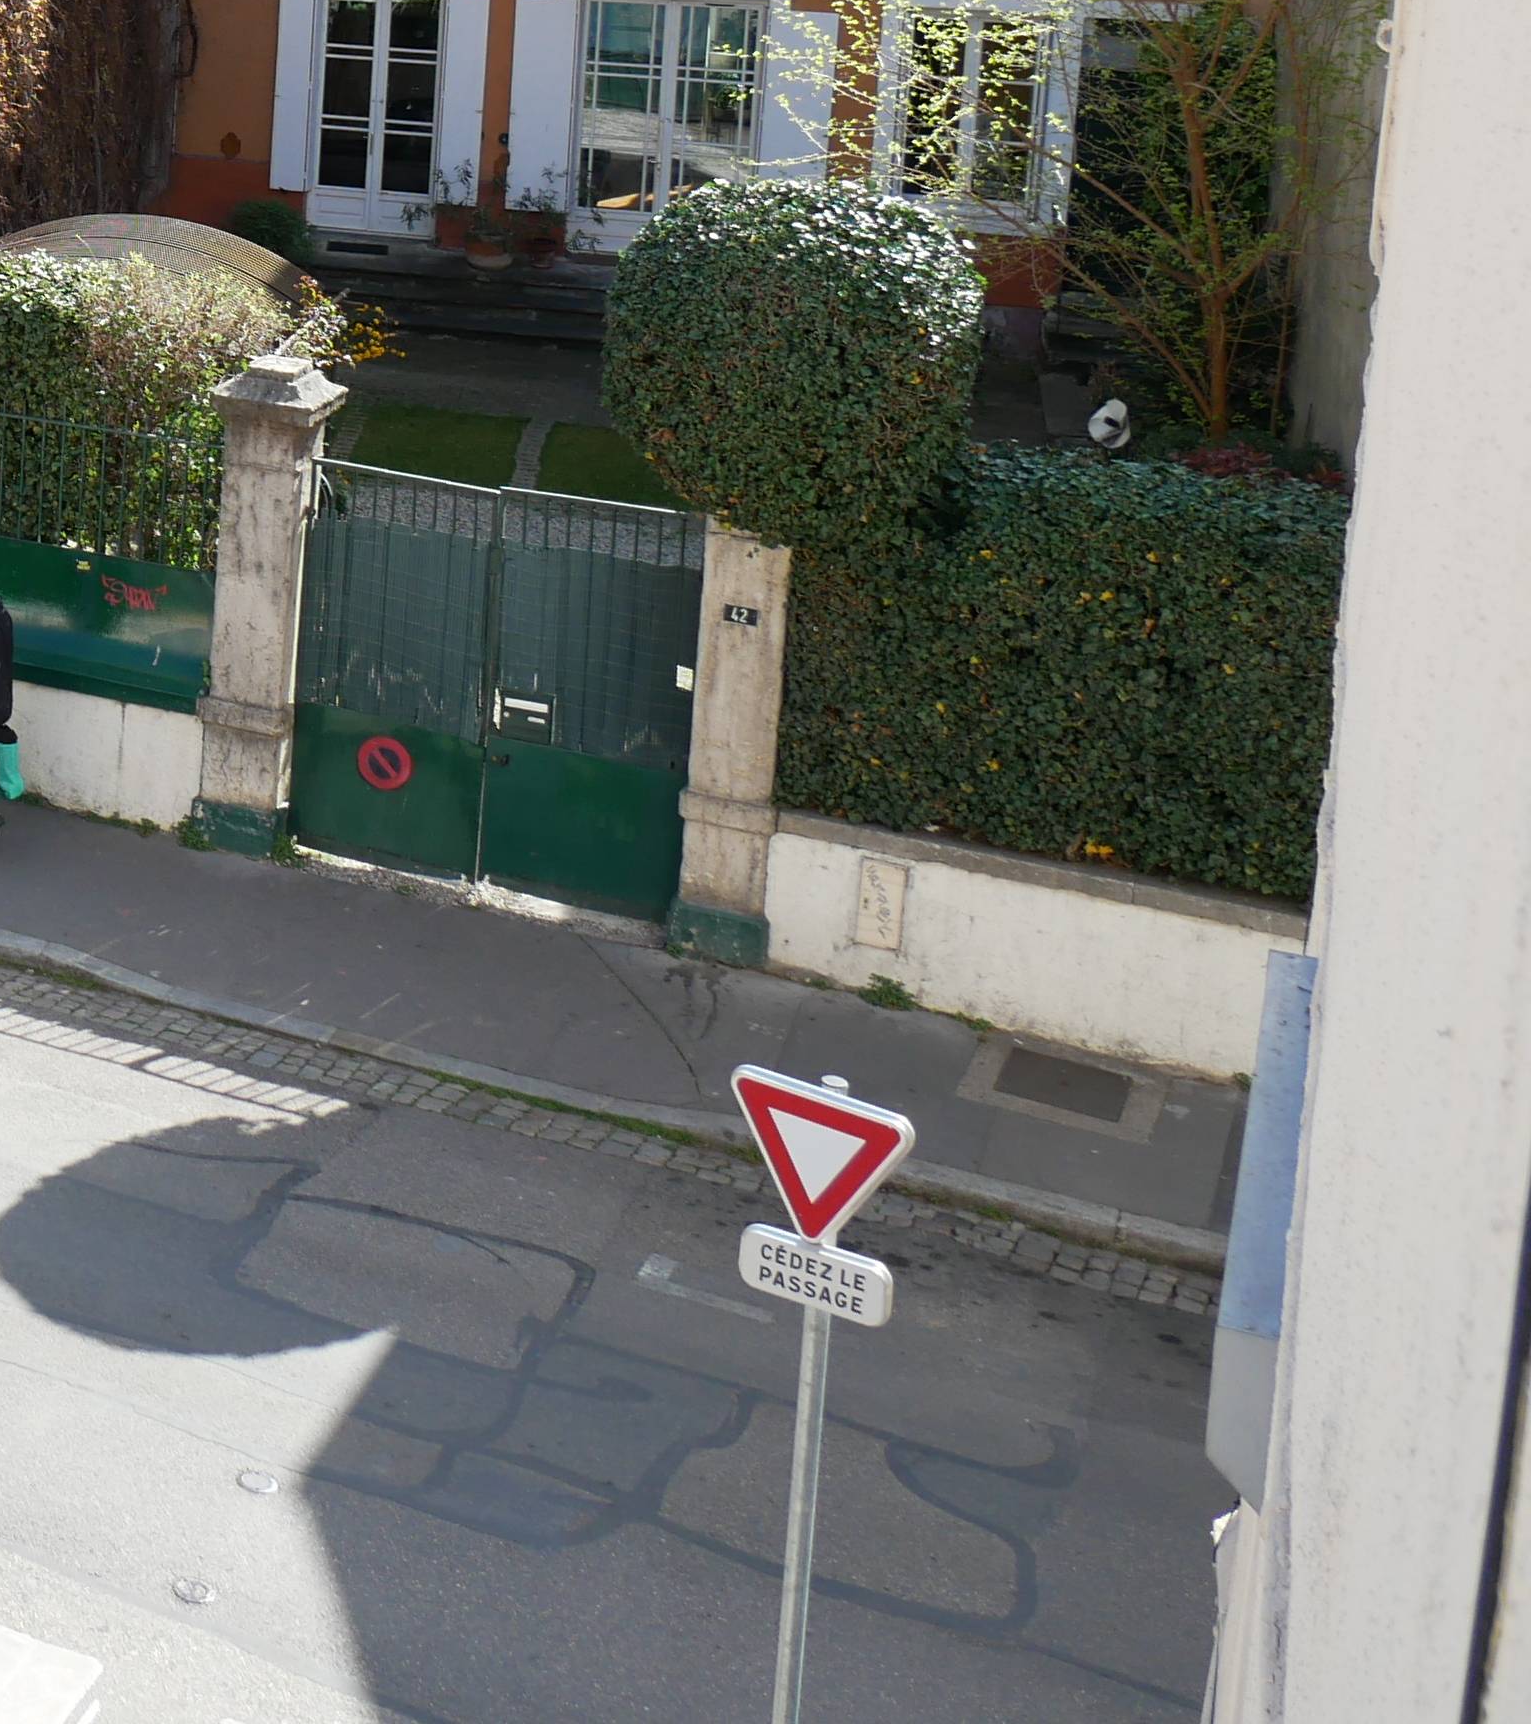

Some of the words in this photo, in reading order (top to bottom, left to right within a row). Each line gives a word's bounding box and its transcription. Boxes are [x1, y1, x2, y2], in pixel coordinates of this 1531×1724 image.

[730, 607, 748, 623] 42
[759, 1265, 864, 1315] PASSAGE
[760, 1243, 833, 1282] CÉDEZ
[840, 1269, 867, 1293] LE
